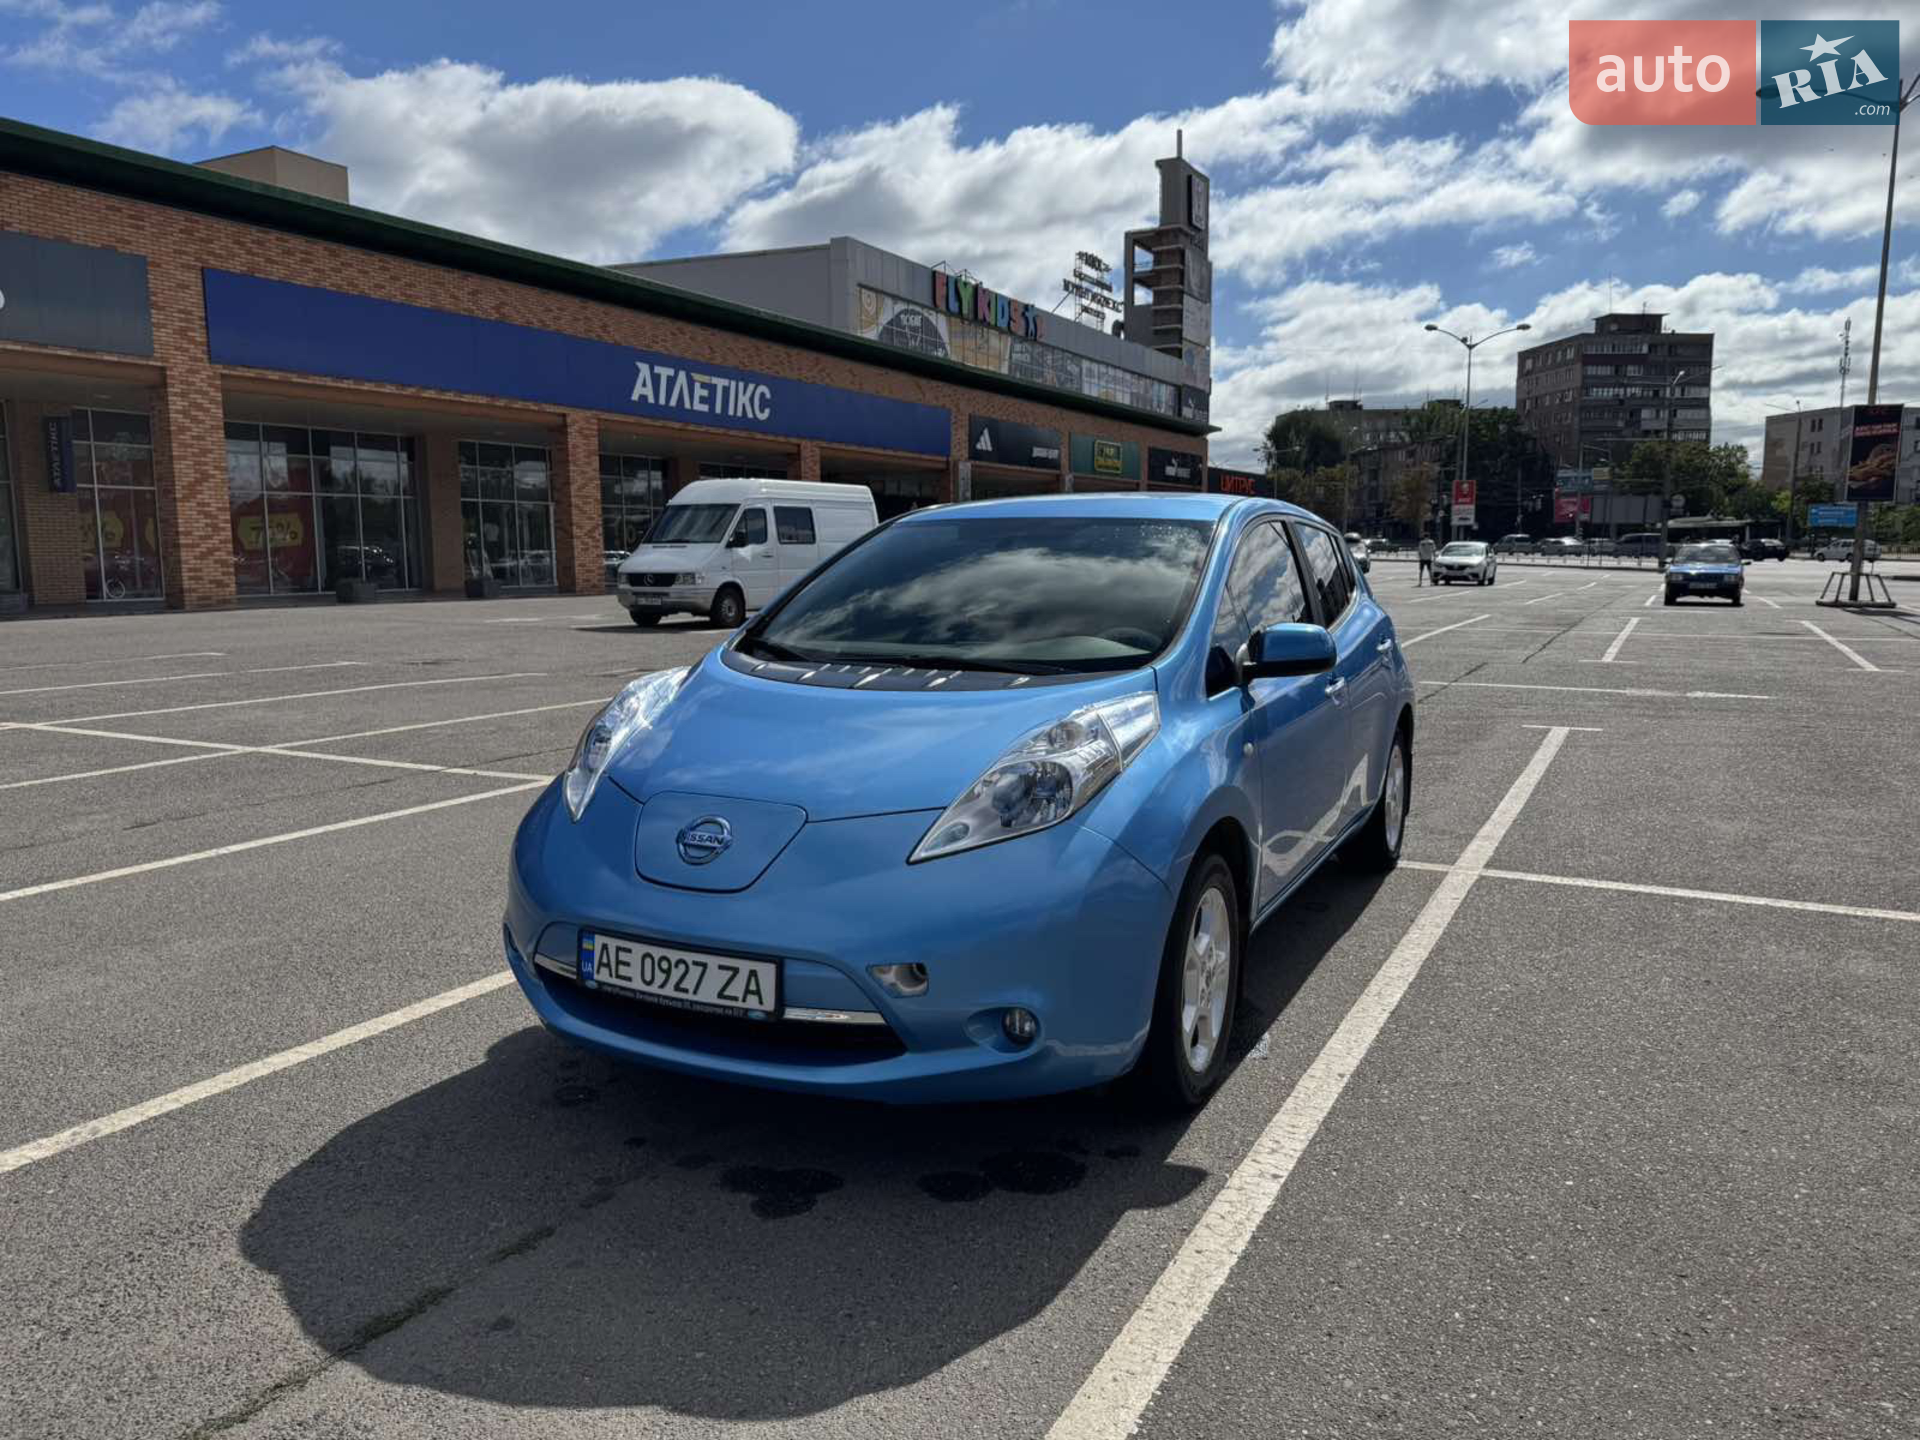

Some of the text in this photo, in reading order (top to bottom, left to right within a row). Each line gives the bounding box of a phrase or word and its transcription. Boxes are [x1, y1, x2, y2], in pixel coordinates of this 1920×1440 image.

[581, 960, 593, 973] UA
[596, 942, 633, 982] AE
[640, 952, 708, 996] 0927
[717, 964, 764, 1006] ZA
